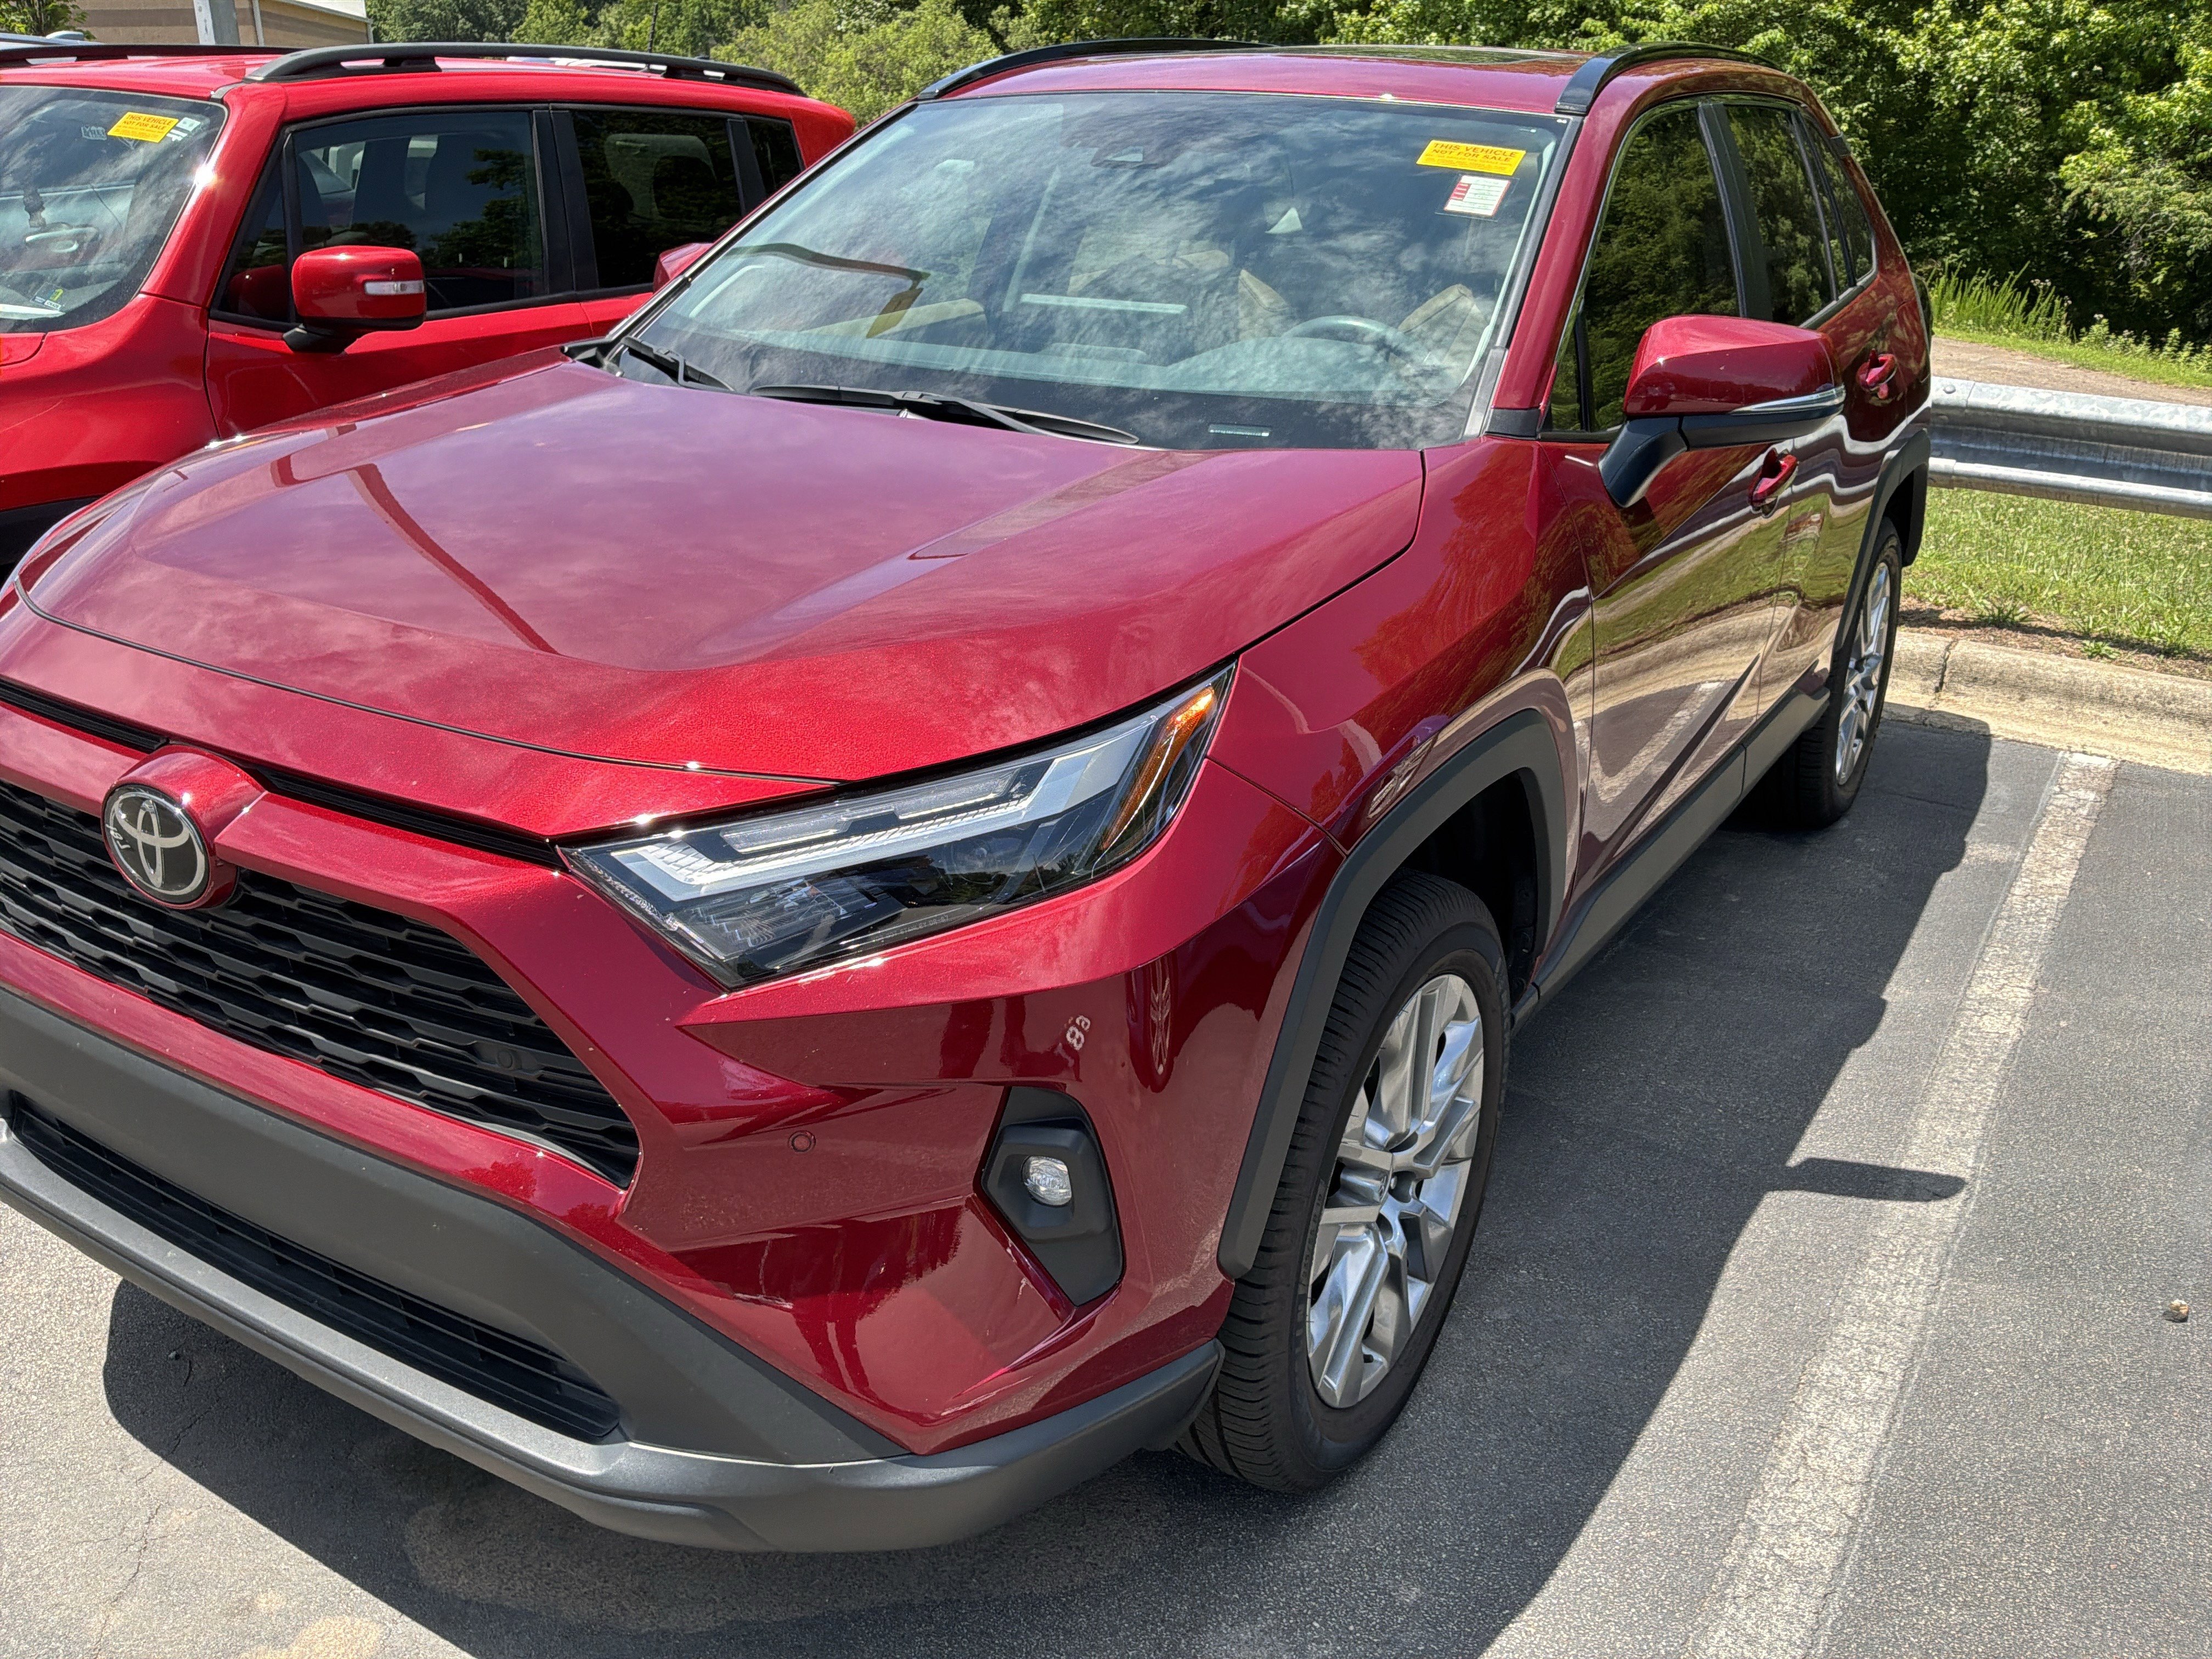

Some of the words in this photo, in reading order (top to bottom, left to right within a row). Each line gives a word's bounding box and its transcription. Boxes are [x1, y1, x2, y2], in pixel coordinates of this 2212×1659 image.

[143, 116, 173, 126] VEHICLE
[1434, 143, 1460, 151] THIS
[1466, 146, 1518, 157] VEHICLE
